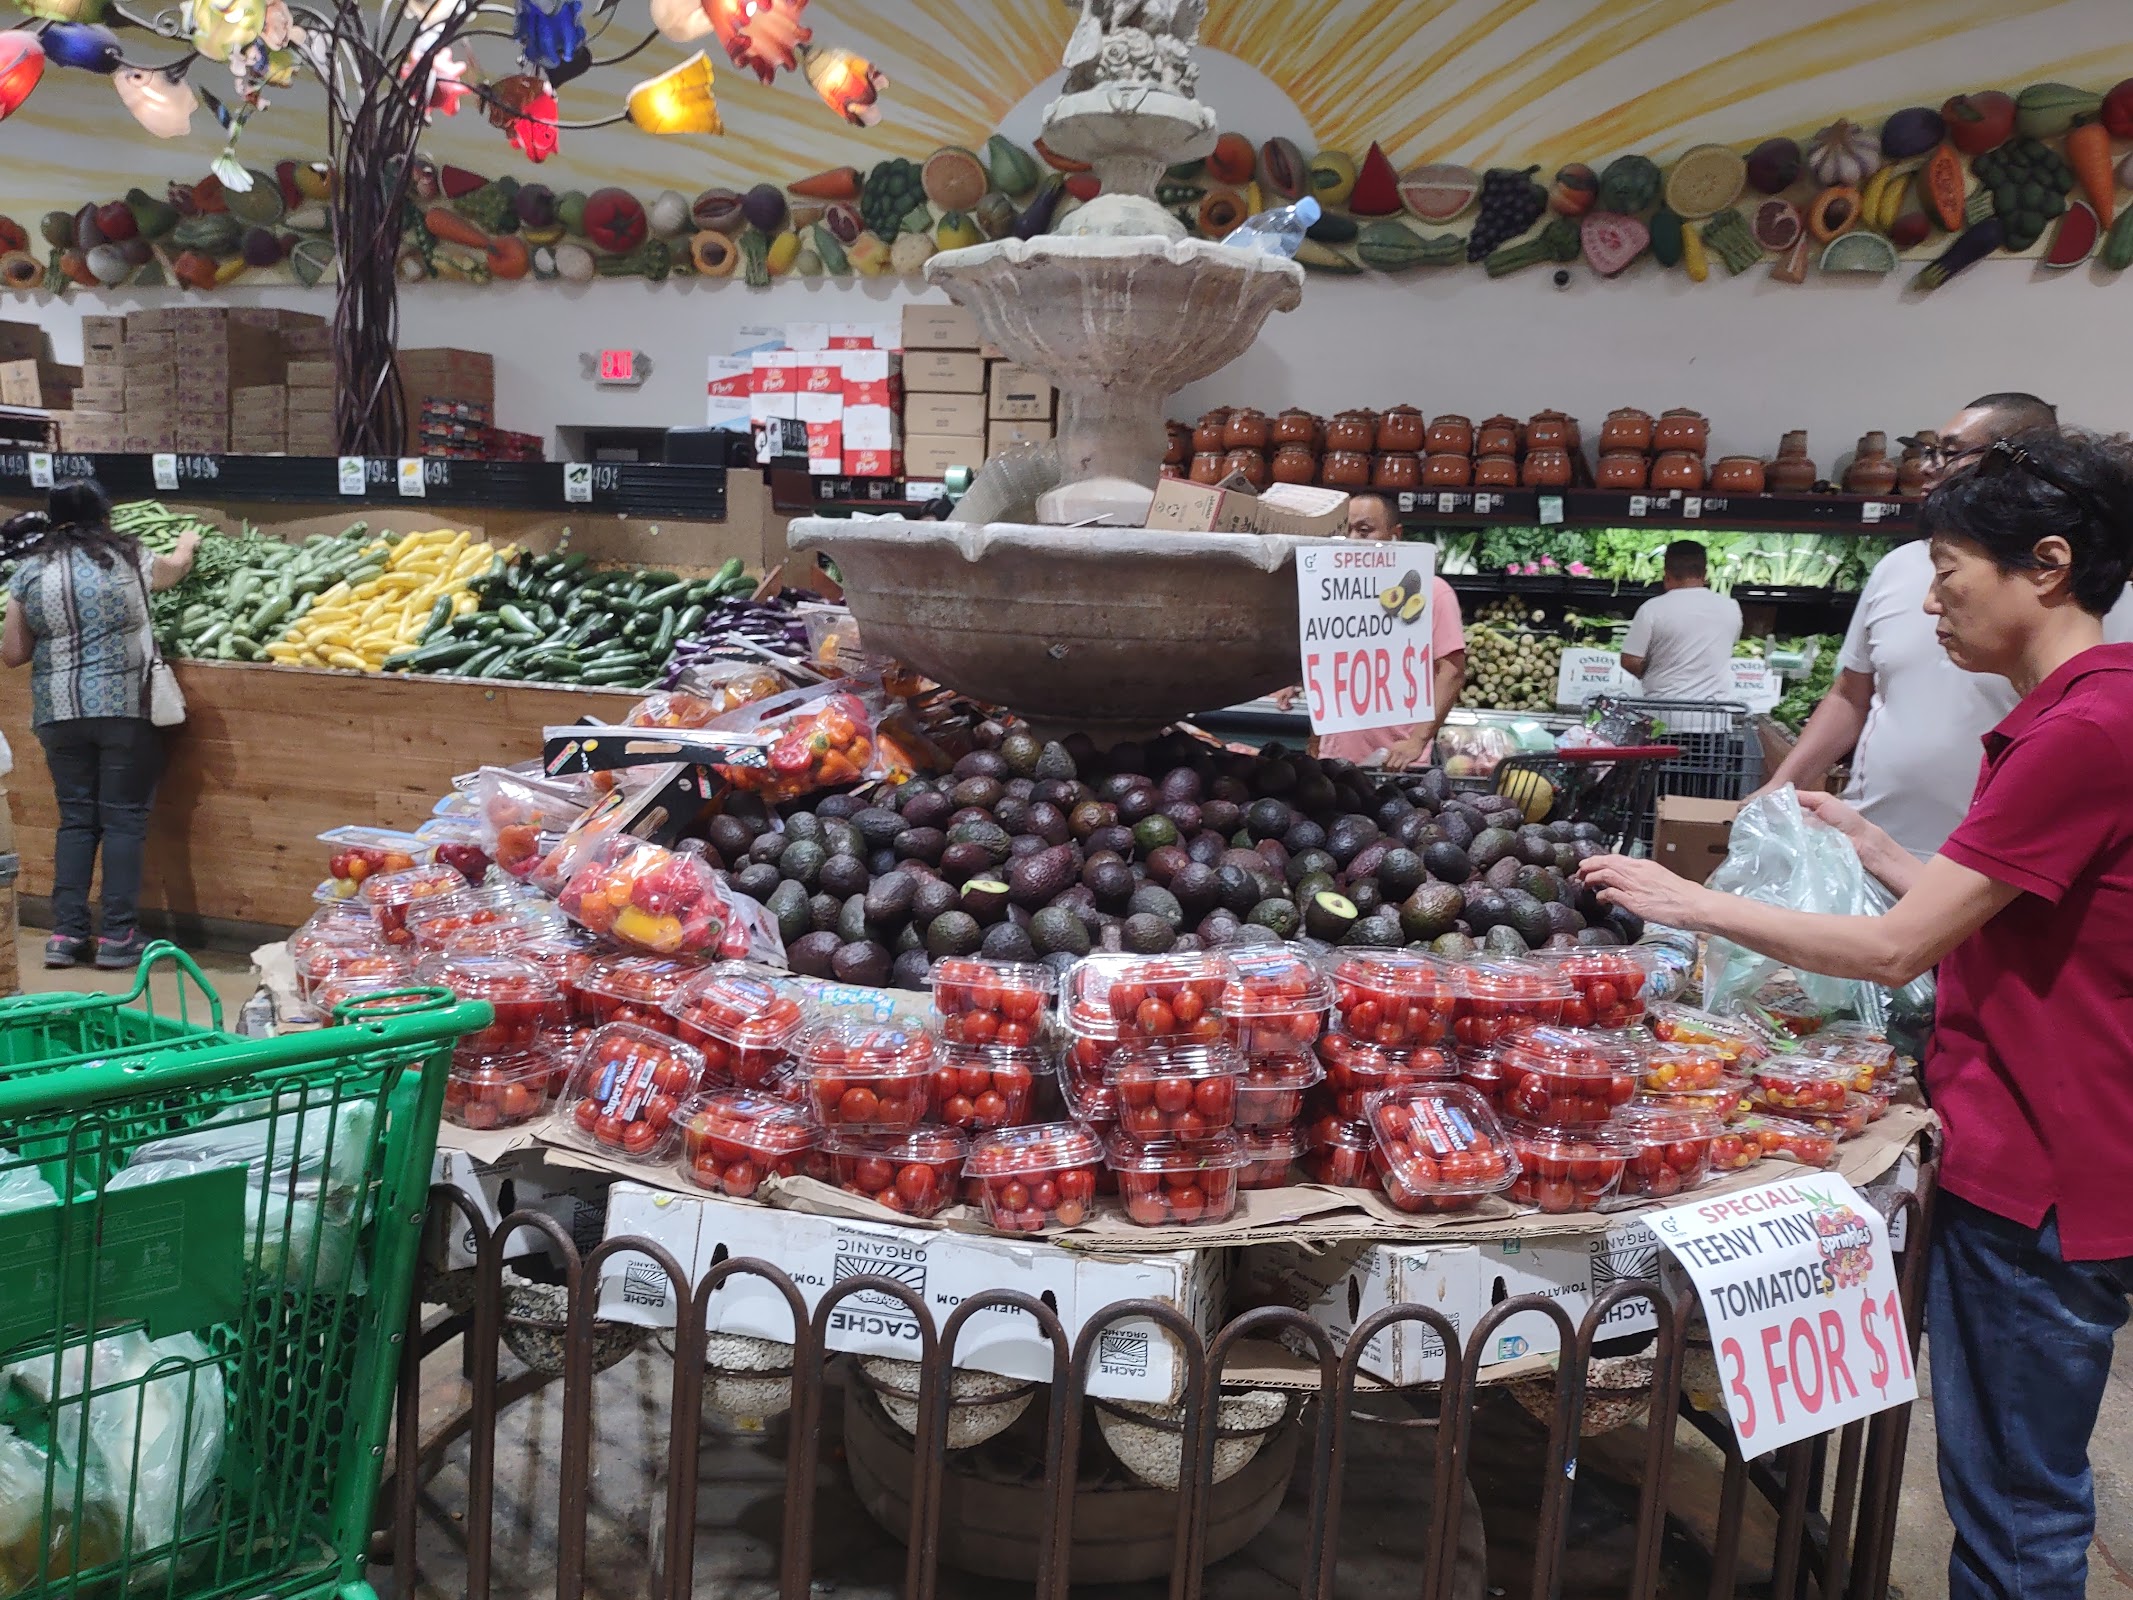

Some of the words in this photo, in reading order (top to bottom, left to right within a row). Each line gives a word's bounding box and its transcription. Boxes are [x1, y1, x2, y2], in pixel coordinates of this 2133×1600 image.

[602, 350, 632, 379] EXIT
[1334, 552, 1396, 568] SPECIAL!
[1321, 577, 1380, 601] SMALL
[1305, 615, 1393, 641] AVOCADO
[1579, 656, 1615, 665] ONION
[1307, 654, 1325, 721] 5
[1334, 648, 1394, 718] FOR
[1402, 638, 1431, 718] $1
[1697, 1184, 1806, 1224] SPECIAL!
[837, 1239, 927, 1262] ORGANIC
[1589, 1230, 1657, 1253] ORGANIC
[1675, 1226, 1763, 1268] TEENY
[1758, 1211, 1822, 1249] TINY
[1820, 1223, 1872, 1259] sprinkles
[623, 1294, 664, 1308] CACHE
[1710, 1260, 1835, 1321] TOMATOES
[831, 1313, 921, 1340] CACHE
[1102, 1329, 1148, 1339] ORGANIC
[1101, 1365, 1147, 1377] CACHE
[1721, 1337, 1757, 1439] 3
[1760, 1309, 1860, 1425] FOR
[1860, 1287, 1911, 1401] $1
